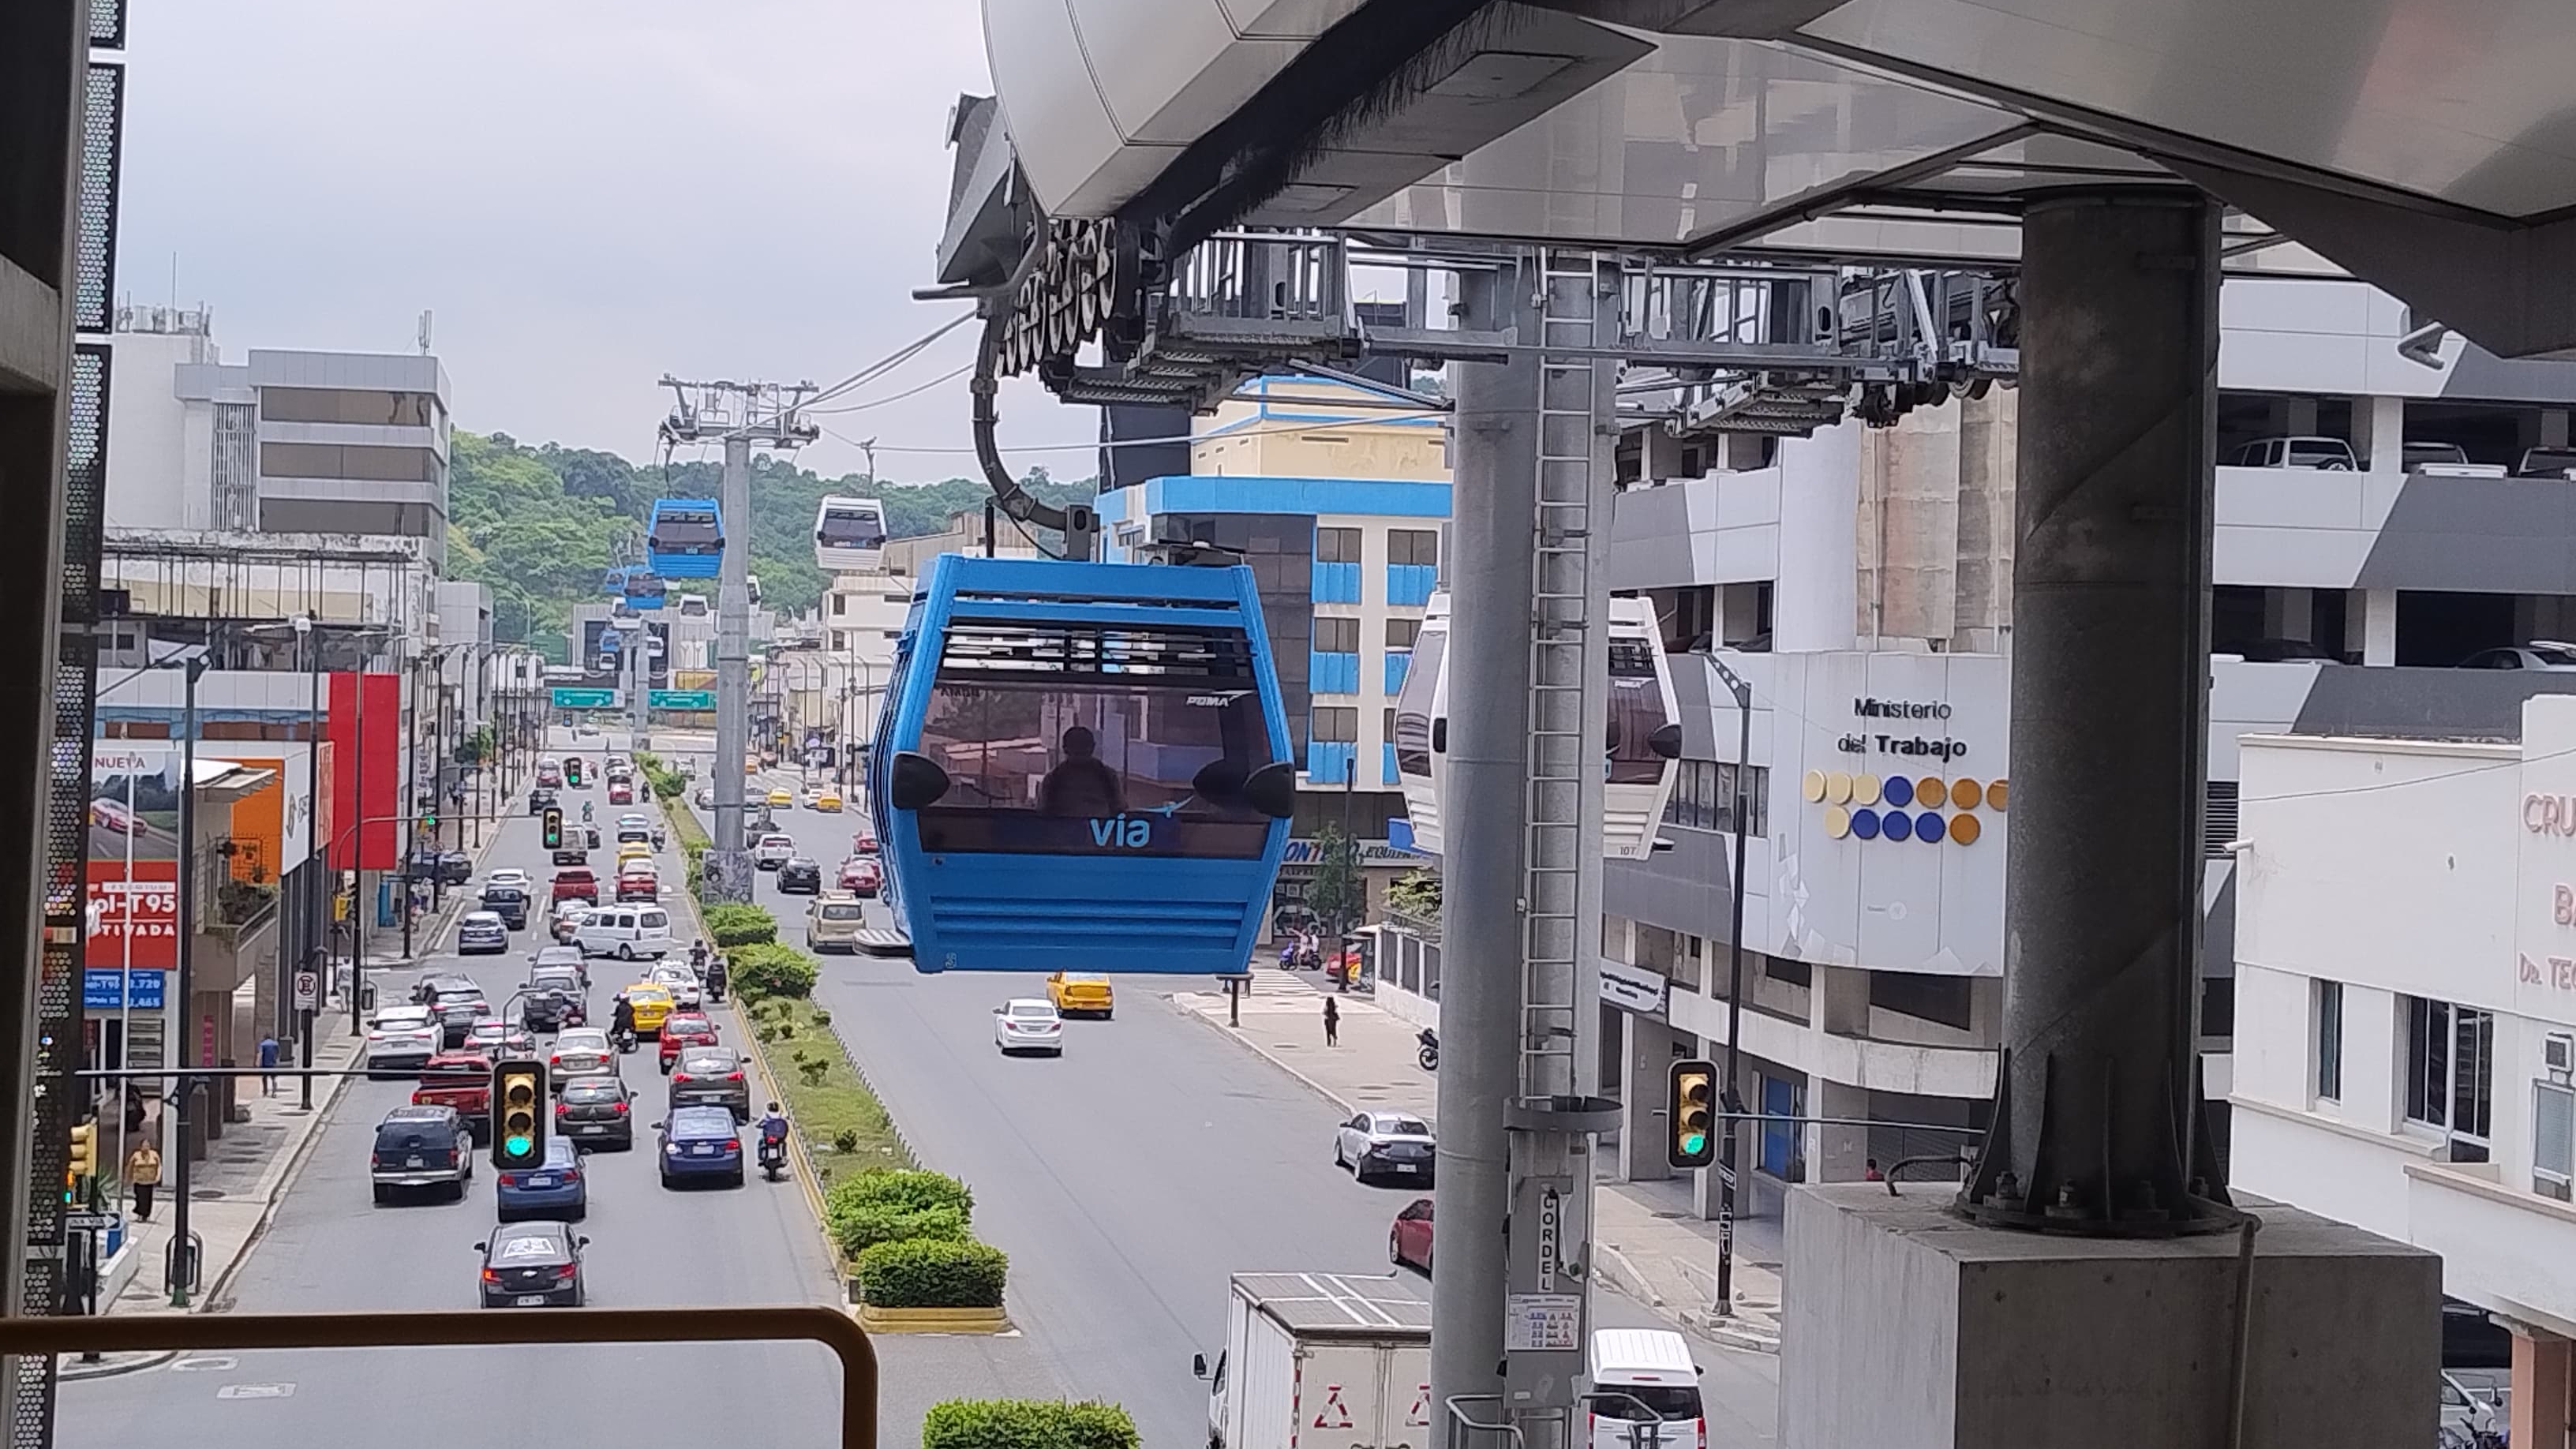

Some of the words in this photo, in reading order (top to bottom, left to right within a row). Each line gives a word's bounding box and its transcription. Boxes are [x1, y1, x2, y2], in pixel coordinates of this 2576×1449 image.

[1186, 696, 1229, 707] POMA
[1854, 698, 1952, 720] Ministerio
[1838, 733, 1866, 753] del
[1875, 735, 1968, 763] Trabajo
[2554, 885, 2576, 926] B
[101, 924, 175, 937] TIVADA
[1541, 1195, 1555, 1291] CORDEL
